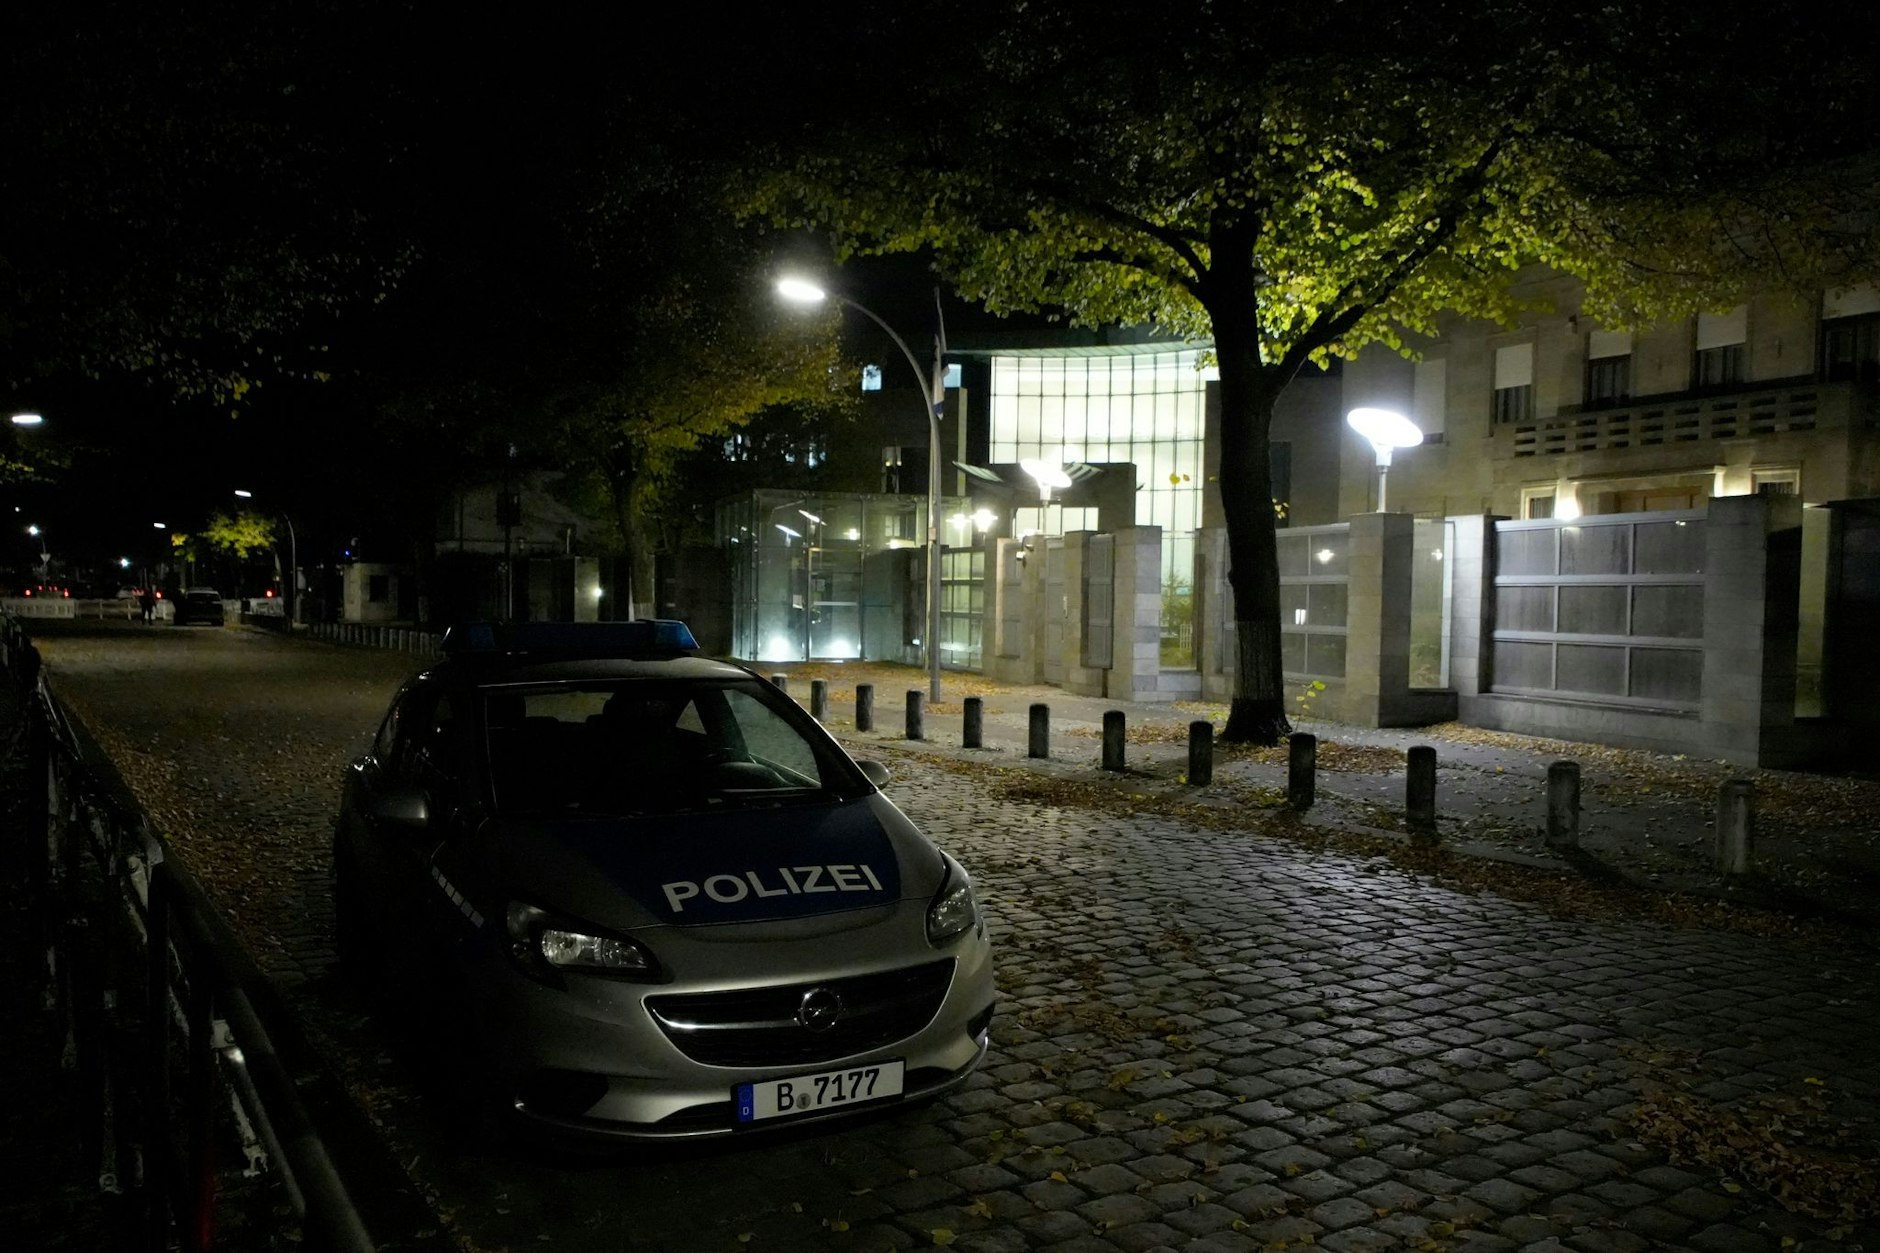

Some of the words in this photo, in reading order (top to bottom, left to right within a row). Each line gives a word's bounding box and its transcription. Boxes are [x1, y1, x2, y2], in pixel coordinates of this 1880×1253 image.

[661, 864, 884, 913] POLIZEI
[742, 1106, 750, 1116] D
[777, 1083, 794, 1111] B
[814, 1068, 880, 1105] 7177
